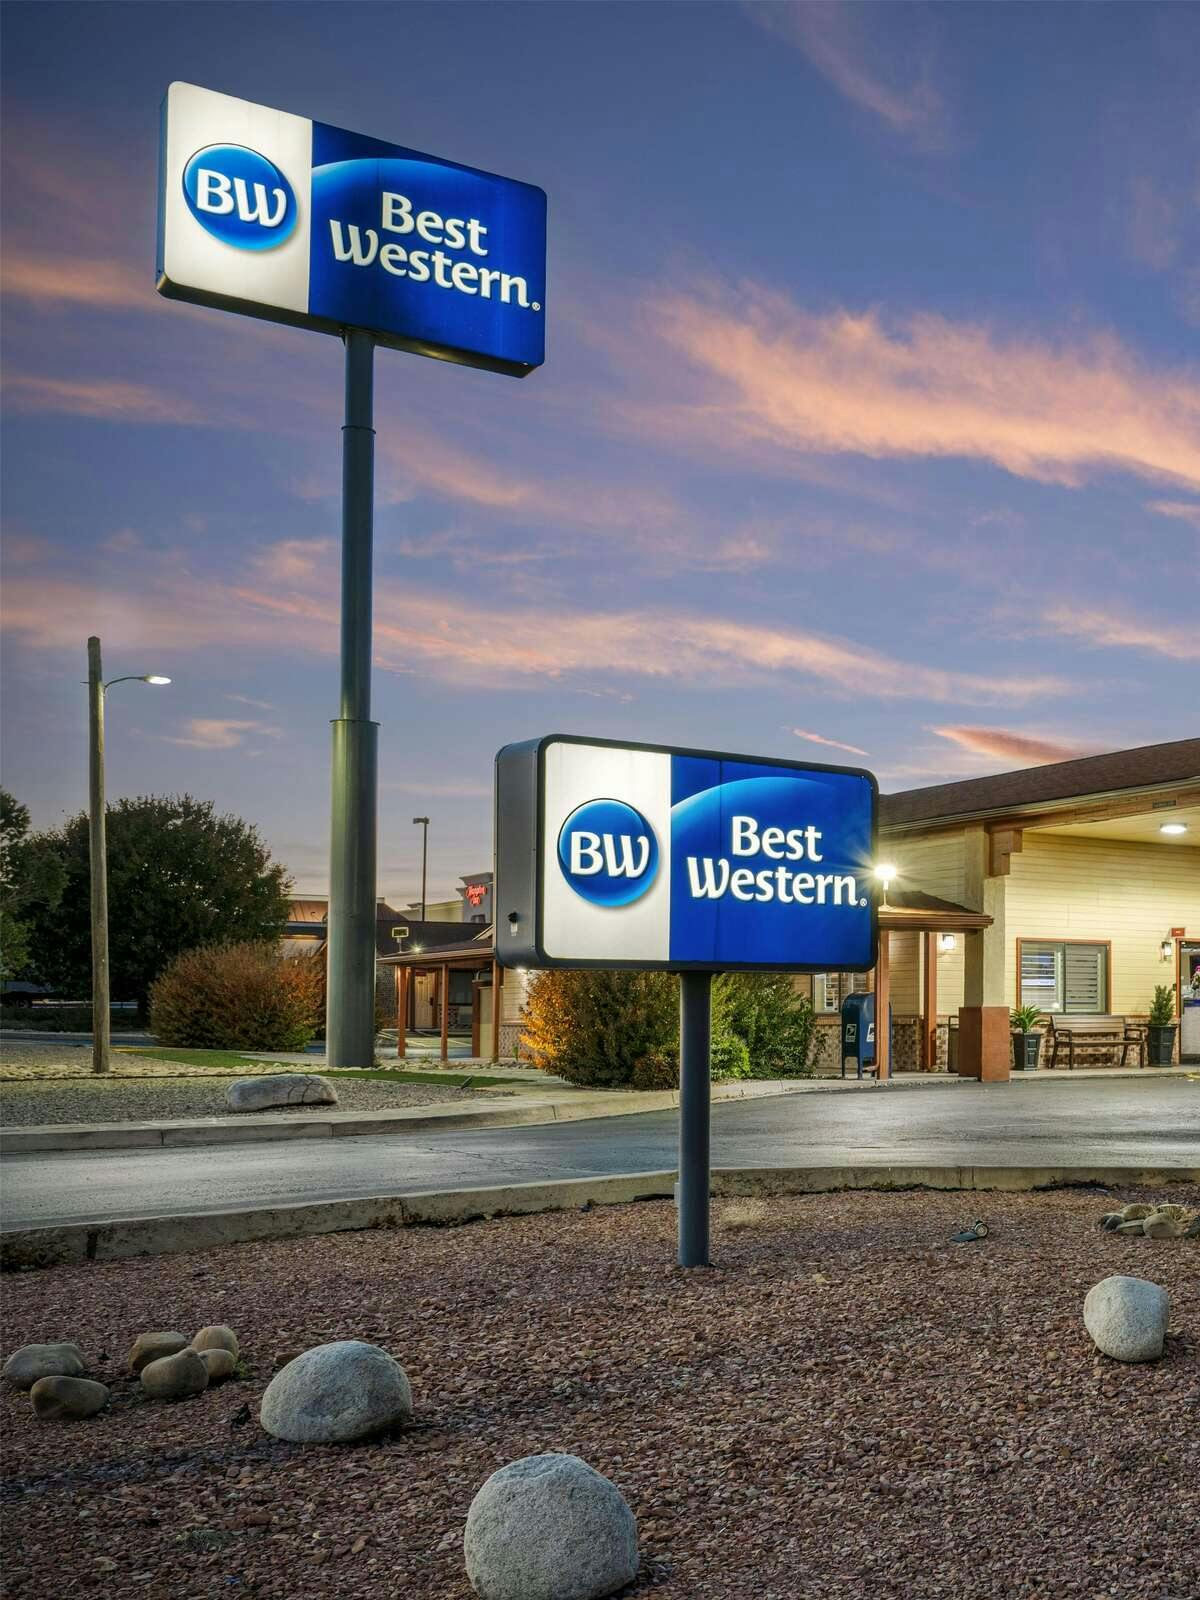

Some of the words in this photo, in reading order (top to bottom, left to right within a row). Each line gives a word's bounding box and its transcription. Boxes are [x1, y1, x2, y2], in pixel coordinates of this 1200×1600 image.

[197, 168, 287, 227] BW
[382, 191, 488, 256] Best
[570, 831, 650, 878] BW
[732, 815, 823, 862] Best
